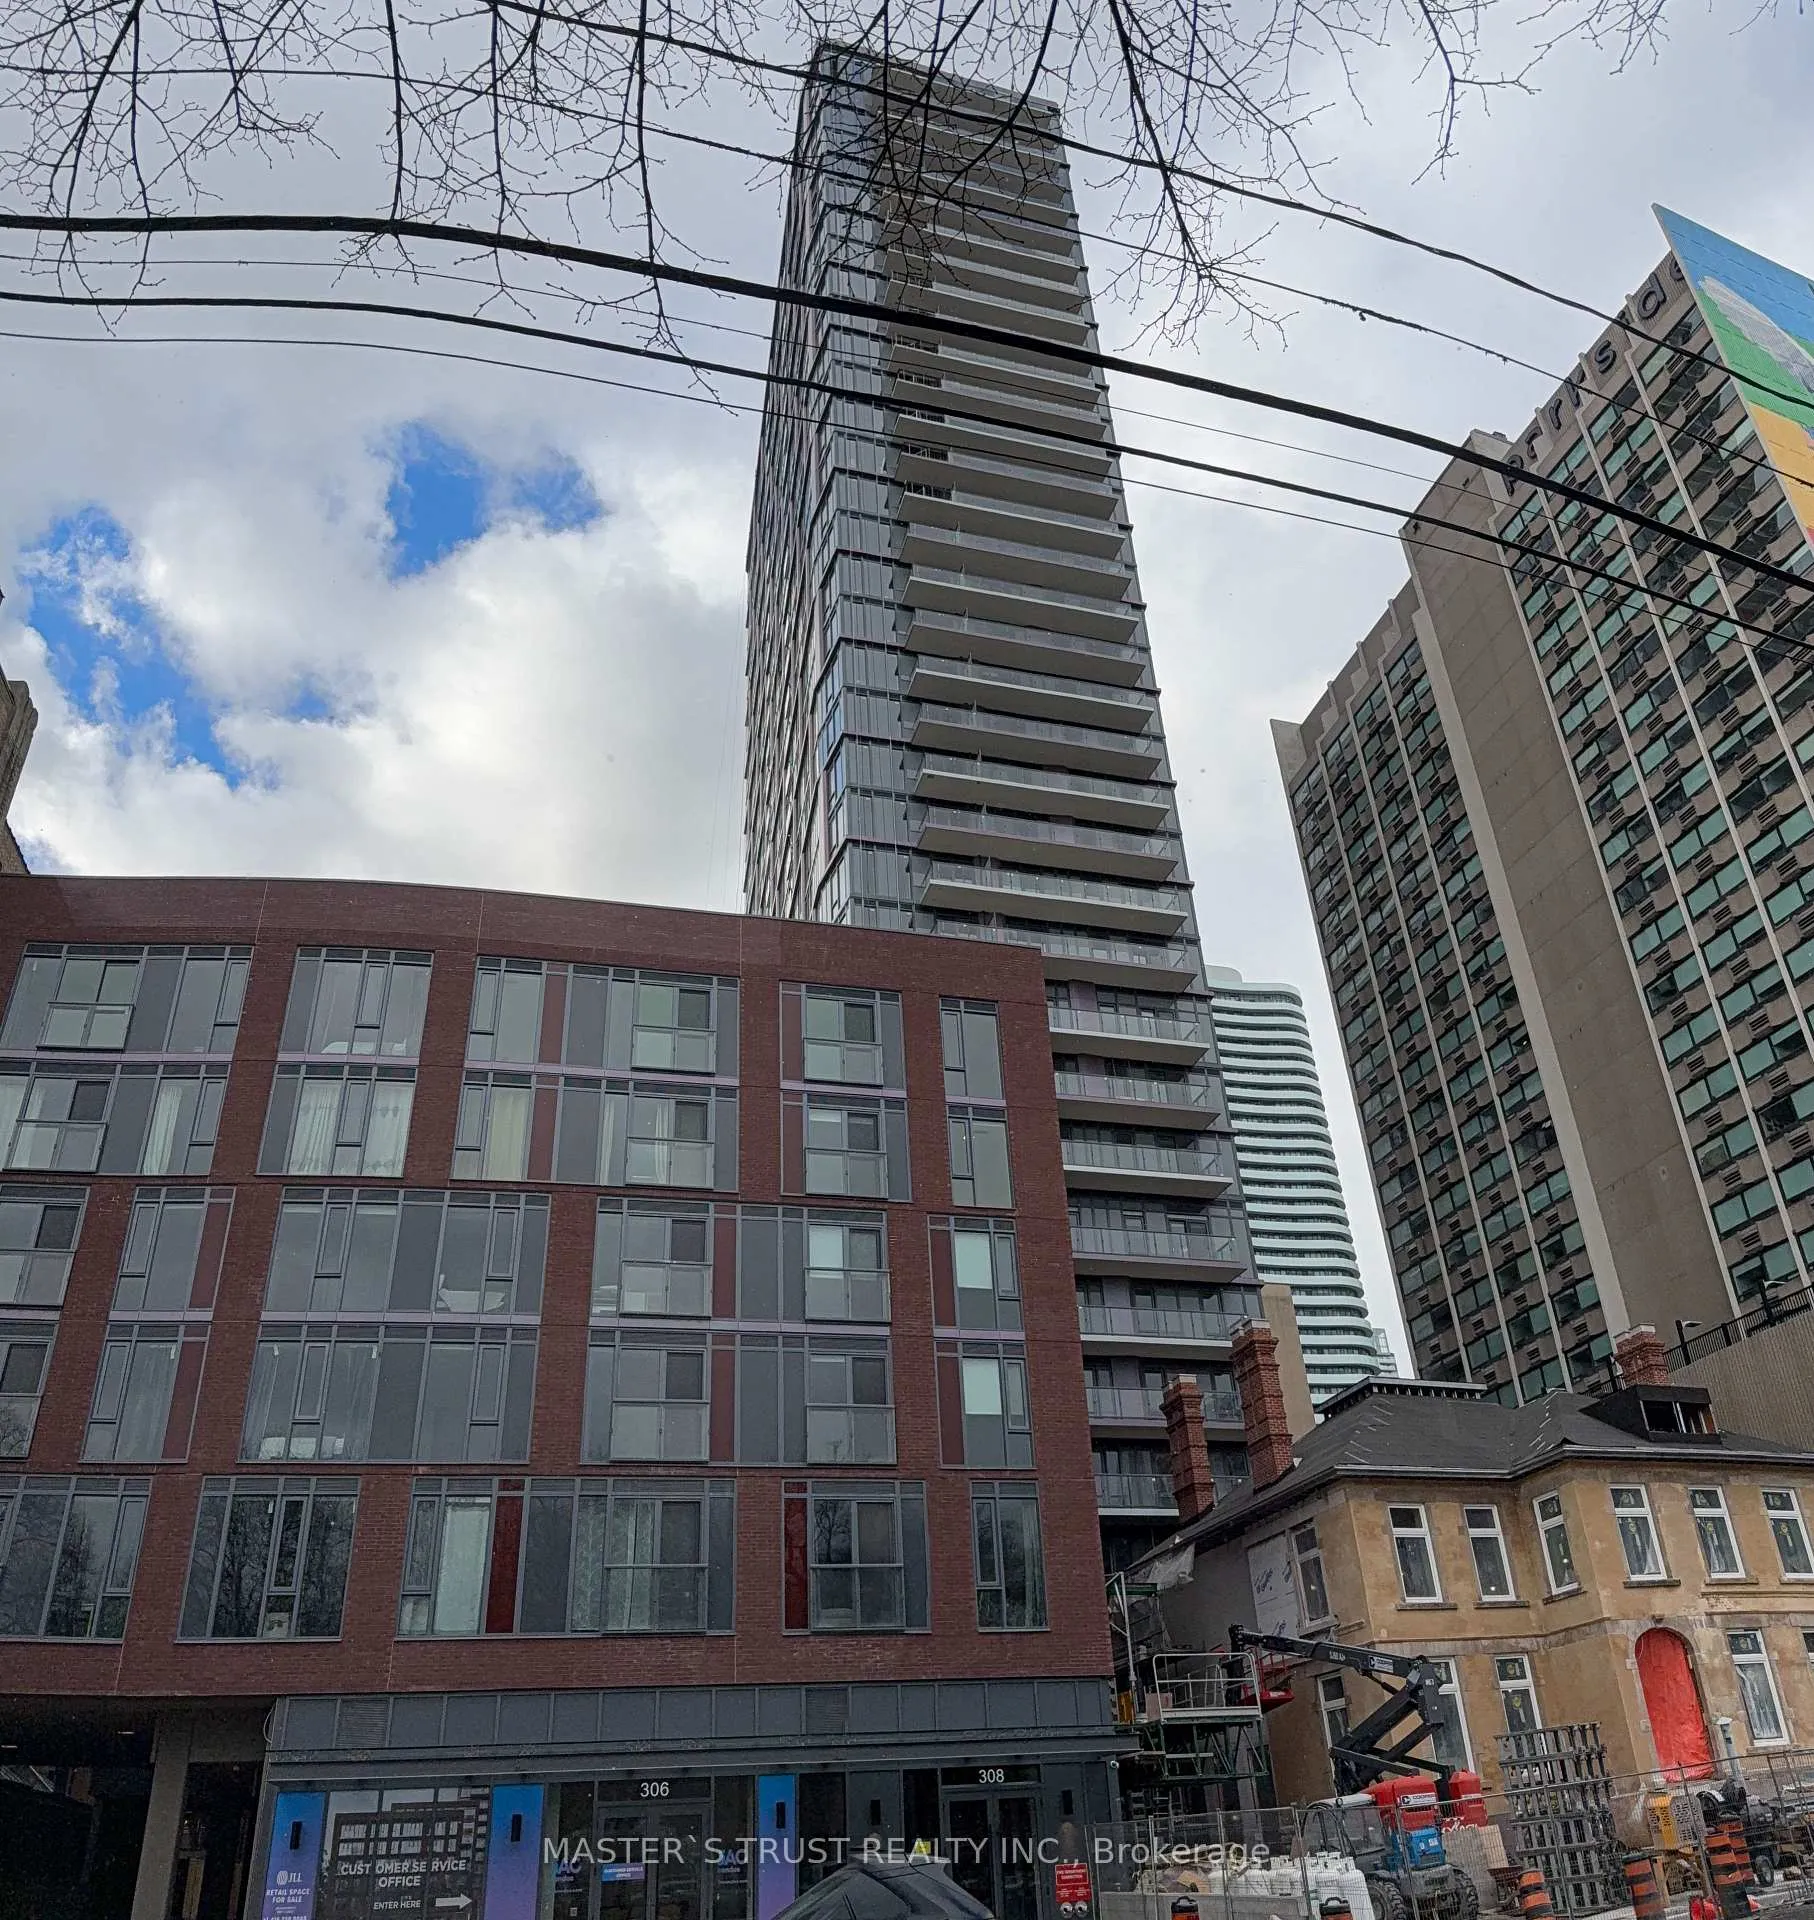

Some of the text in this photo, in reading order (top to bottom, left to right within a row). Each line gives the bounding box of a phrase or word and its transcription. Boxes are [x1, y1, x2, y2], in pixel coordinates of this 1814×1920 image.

[978, 1768, 1005, 1784] 308
[640, 1781, 670, 1798] 306
[378, 1875, 421, 1888] OFFICE
[373, 1899, 421, 1910] ENTER HERE
